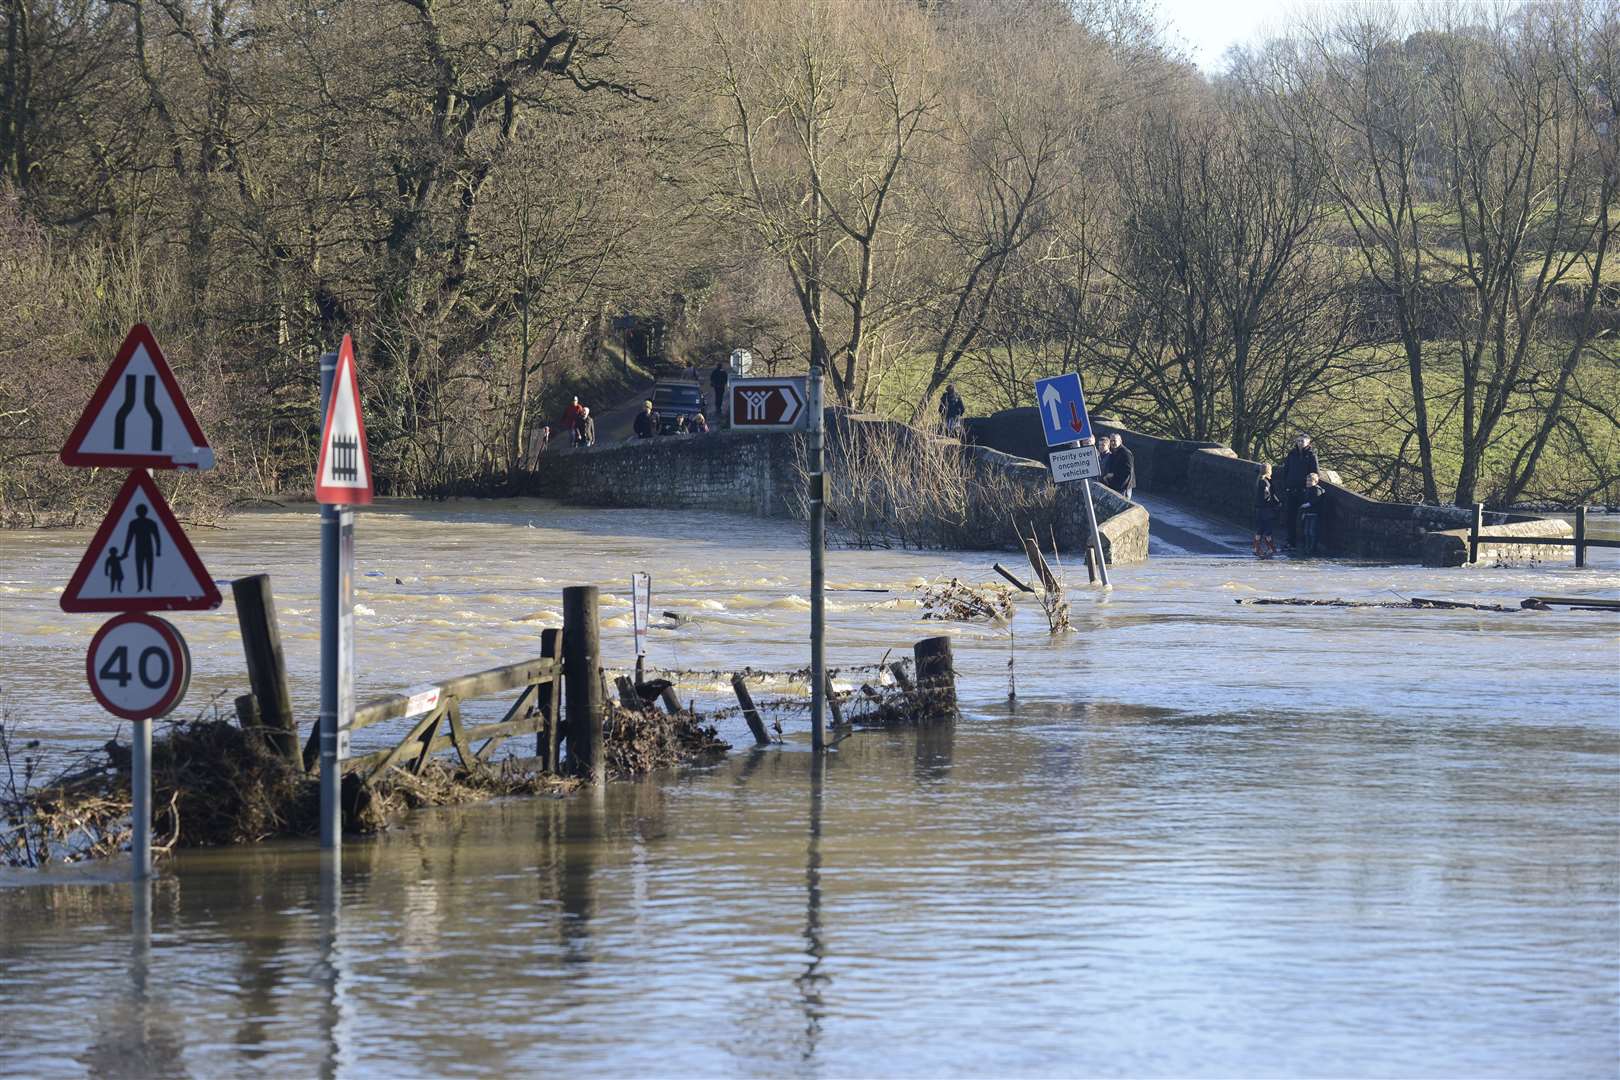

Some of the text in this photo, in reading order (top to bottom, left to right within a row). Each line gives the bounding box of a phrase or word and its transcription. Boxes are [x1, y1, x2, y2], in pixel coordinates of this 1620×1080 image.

[1052, 453, 1077, 462] Priority
[1058, 460, 1090, 470] oncoming
[1063, 469, 1089, 478] vehicles
[99, 645, 170, 690] 40
